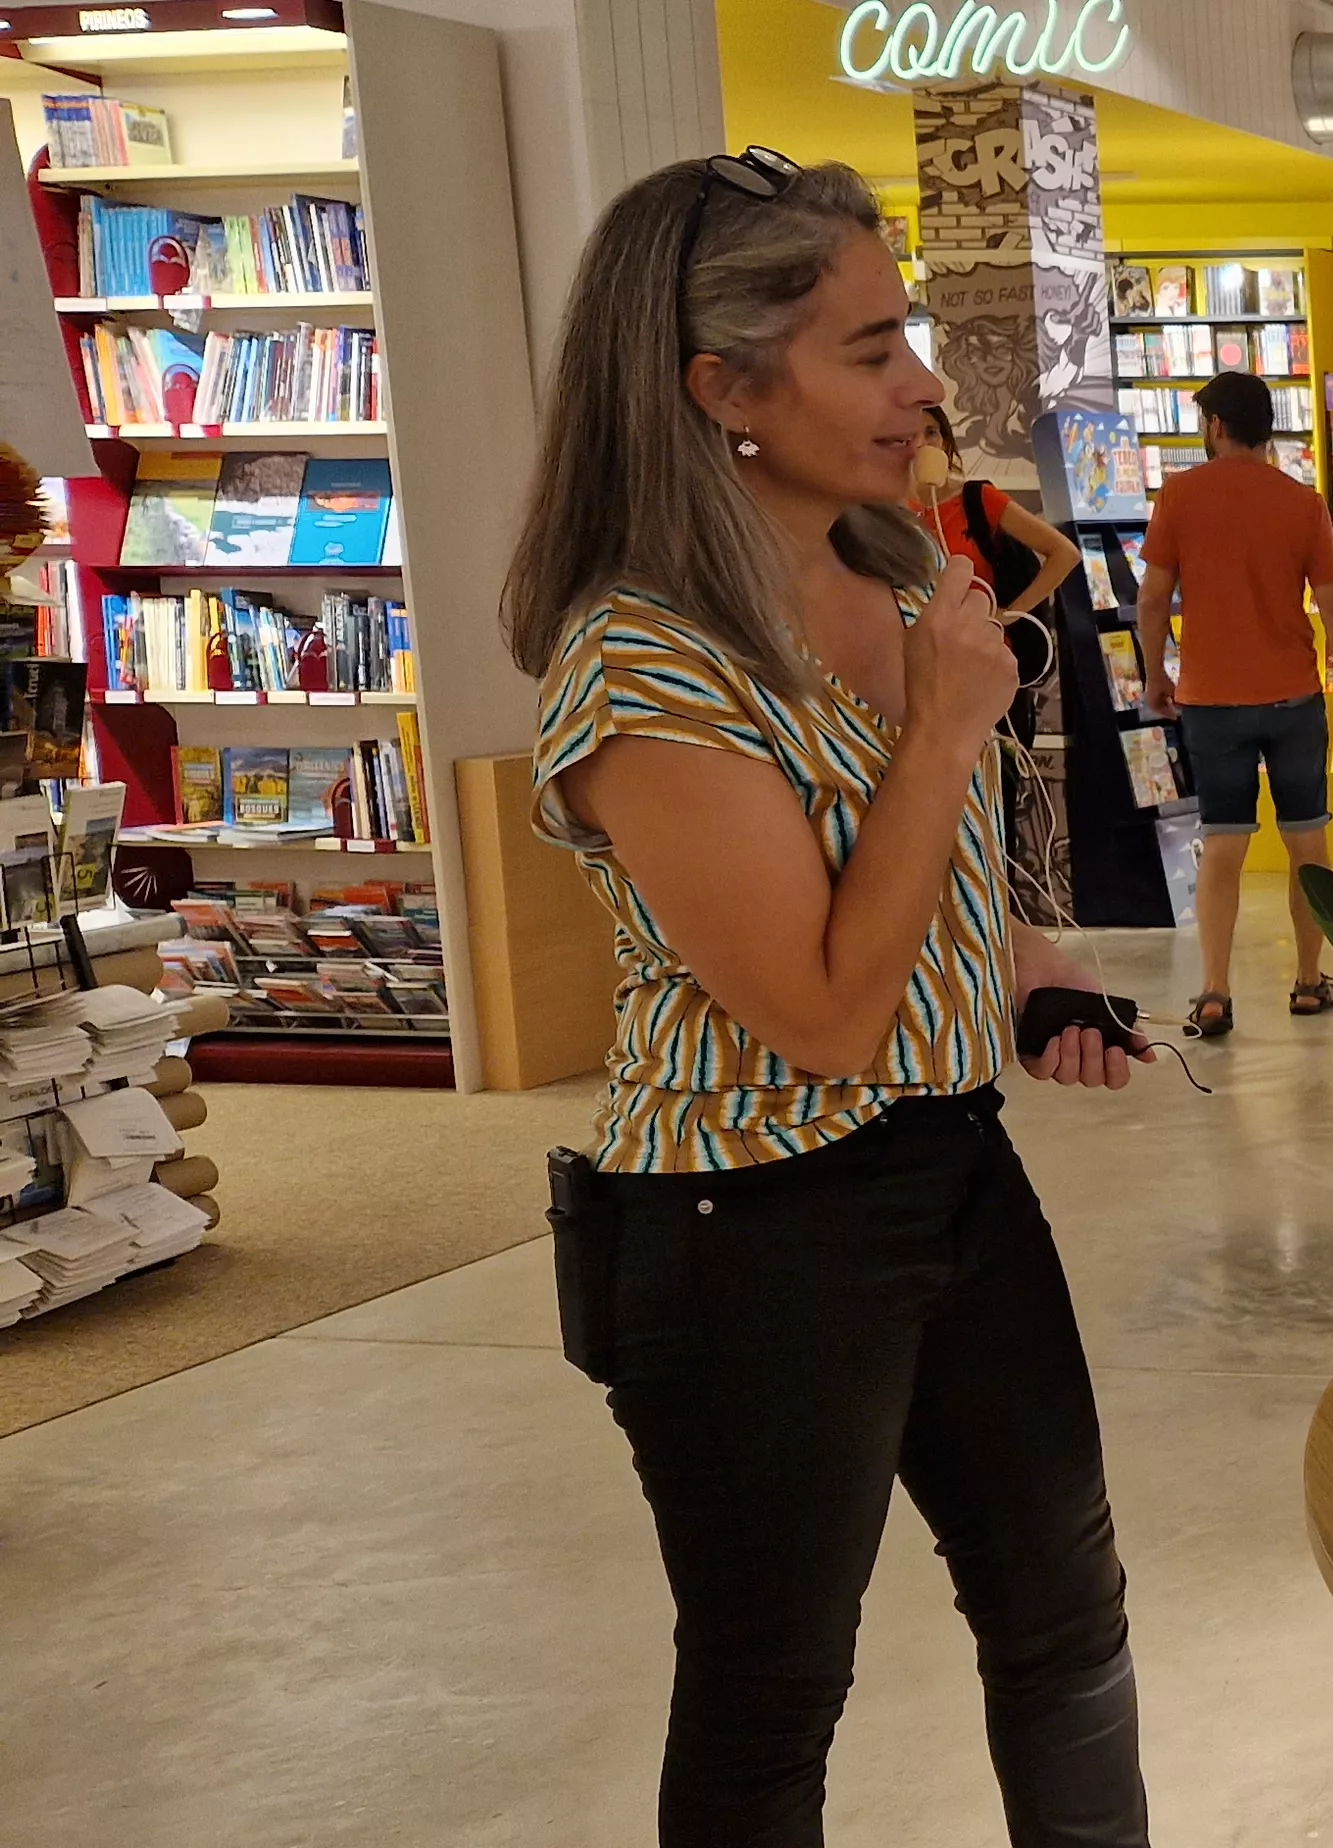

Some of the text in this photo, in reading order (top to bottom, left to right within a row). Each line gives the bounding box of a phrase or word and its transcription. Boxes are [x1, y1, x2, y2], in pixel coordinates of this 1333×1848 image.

[79, 8, 150, 32] PIRINEOS
[840, 0, 1129, 80] comic
[940, 291, 968, 308] NOT
[974, 289, 995, 306] SO
[998, 284, 1036, 303] FAST
[238, 802, 280, 815] BOSQUES
